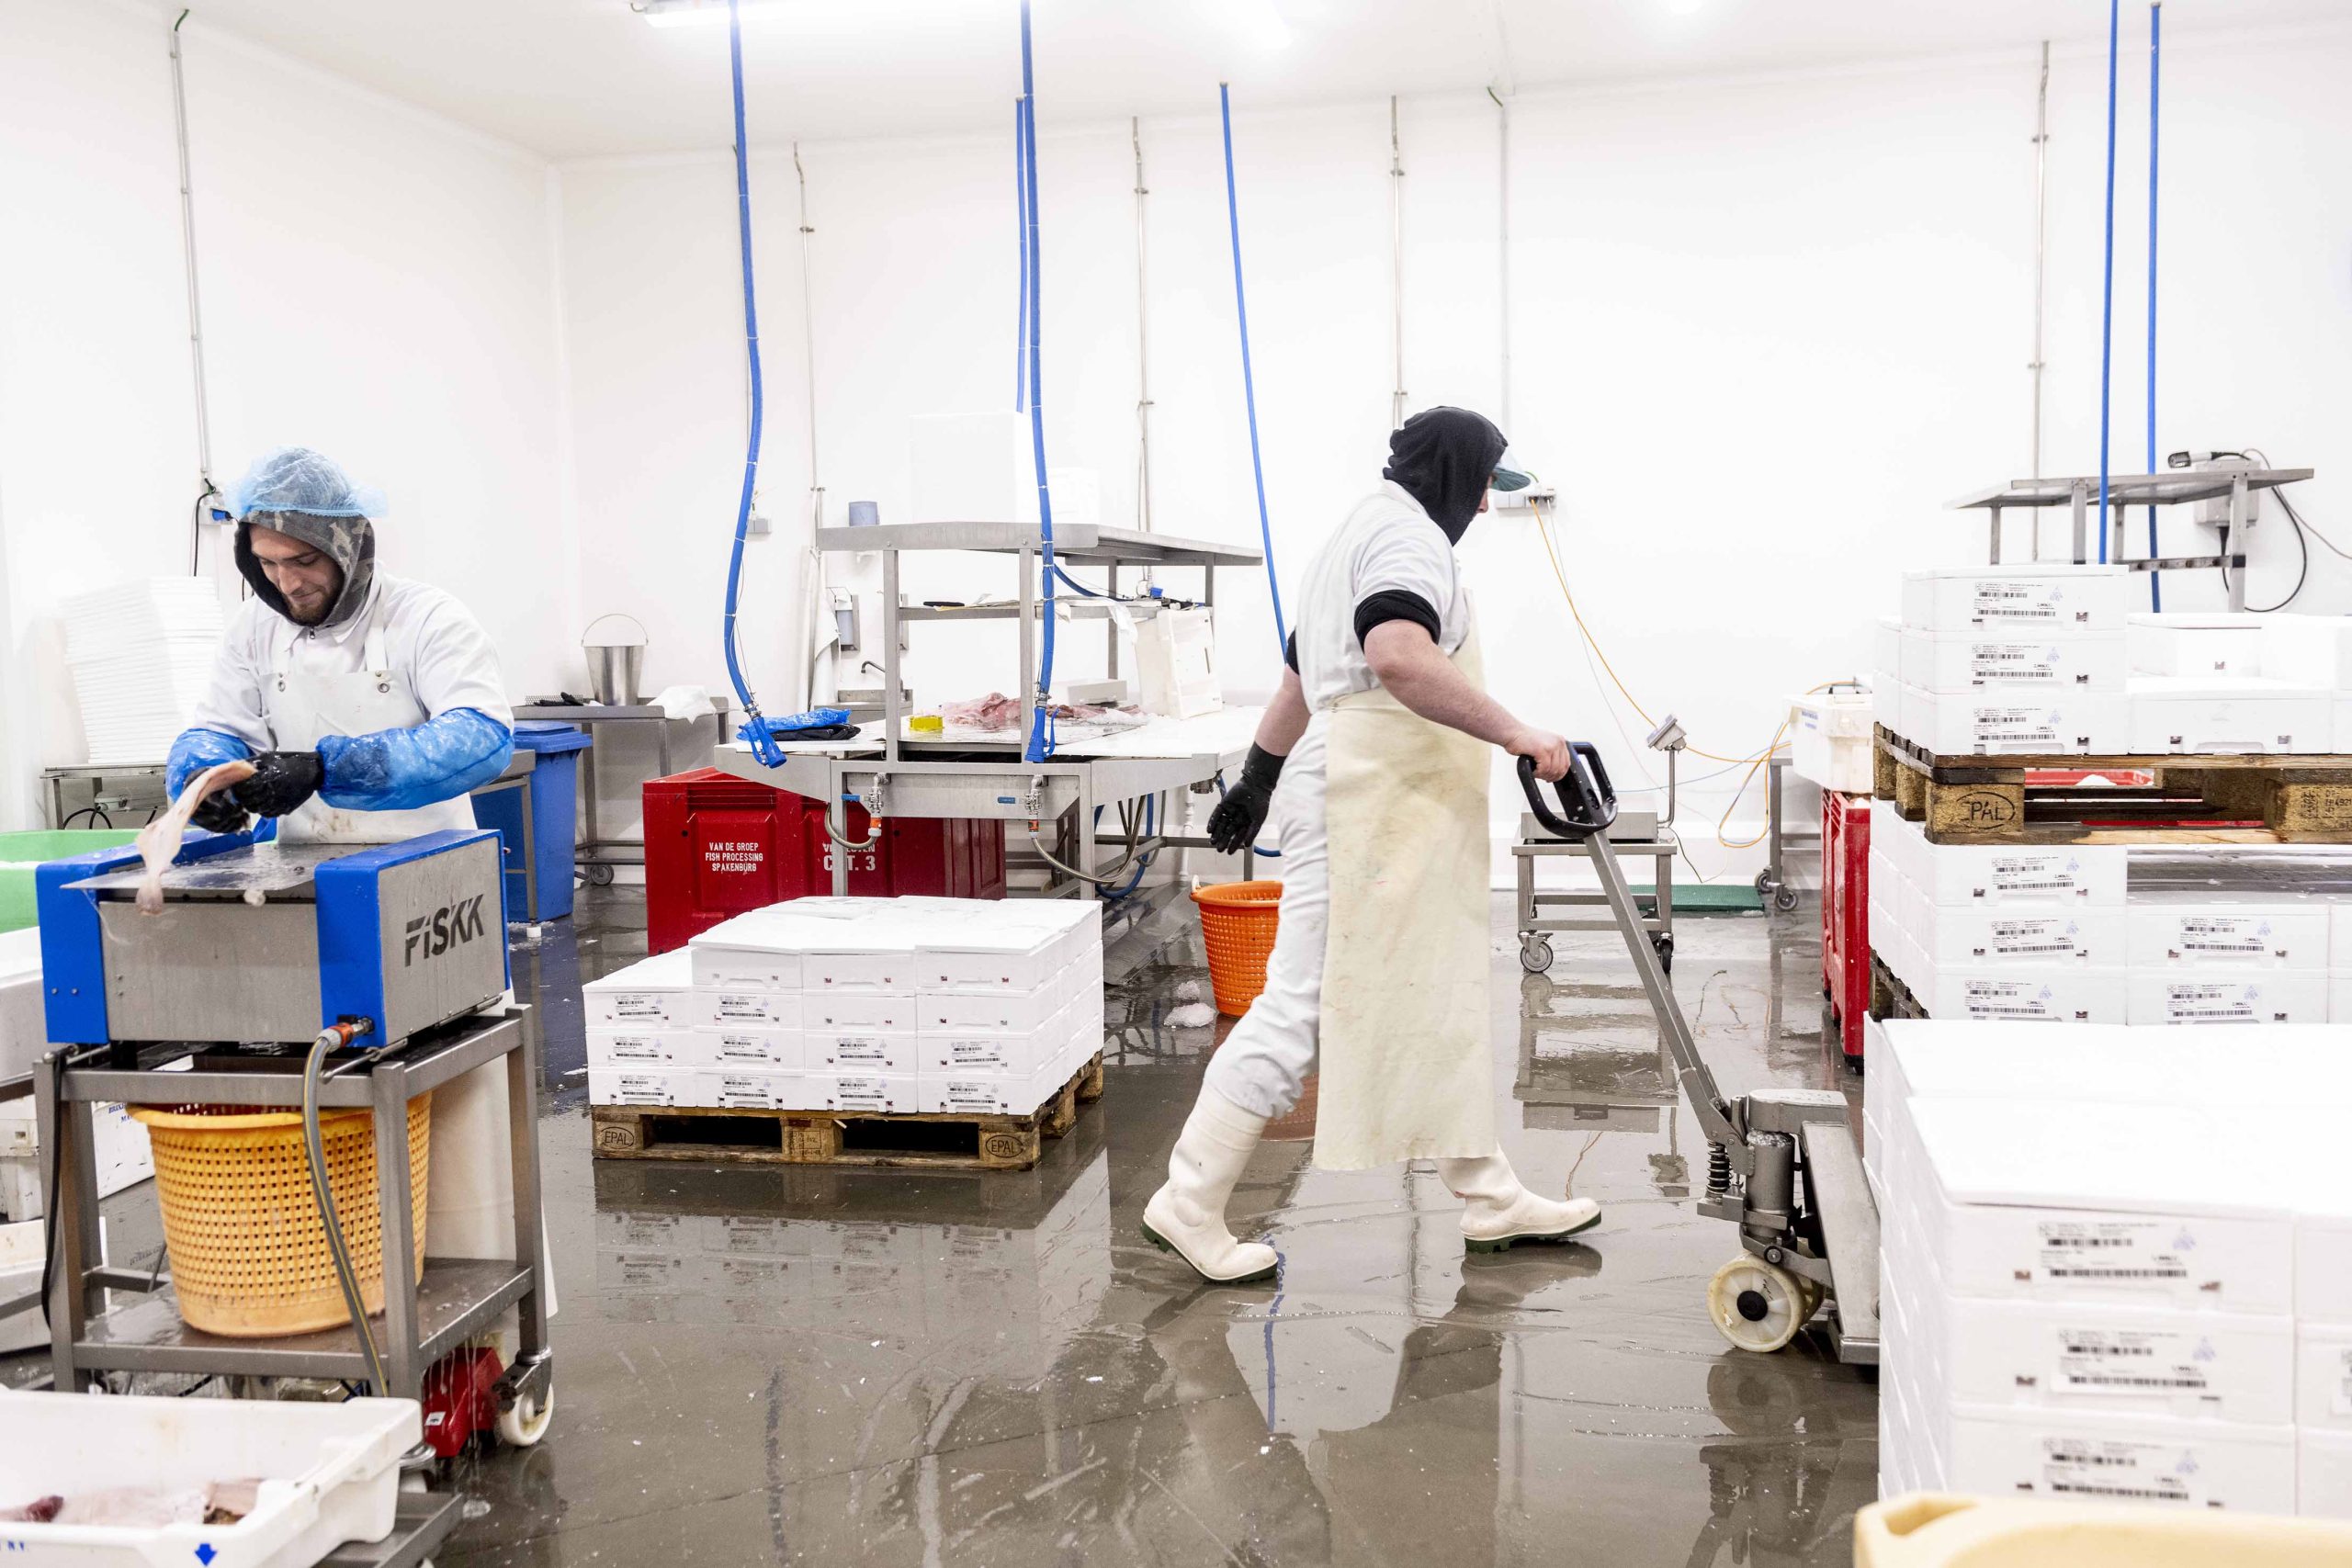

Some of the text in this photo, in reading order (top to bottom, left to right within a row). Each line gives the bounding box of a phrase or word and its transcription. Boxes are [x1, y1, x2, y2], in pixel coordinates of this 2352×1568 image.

[708, 842, 759, 852] VAN DE GROEP
[705, 852, 763, 862] FISH PROCESSING
[823, 854, 876, 871] CT. 3
[712, 863, 757, 872] SPAKENBURG
[605, 1131, 629, 1145] EPAL
[991, 1139, 1015, 1154] EPAL
